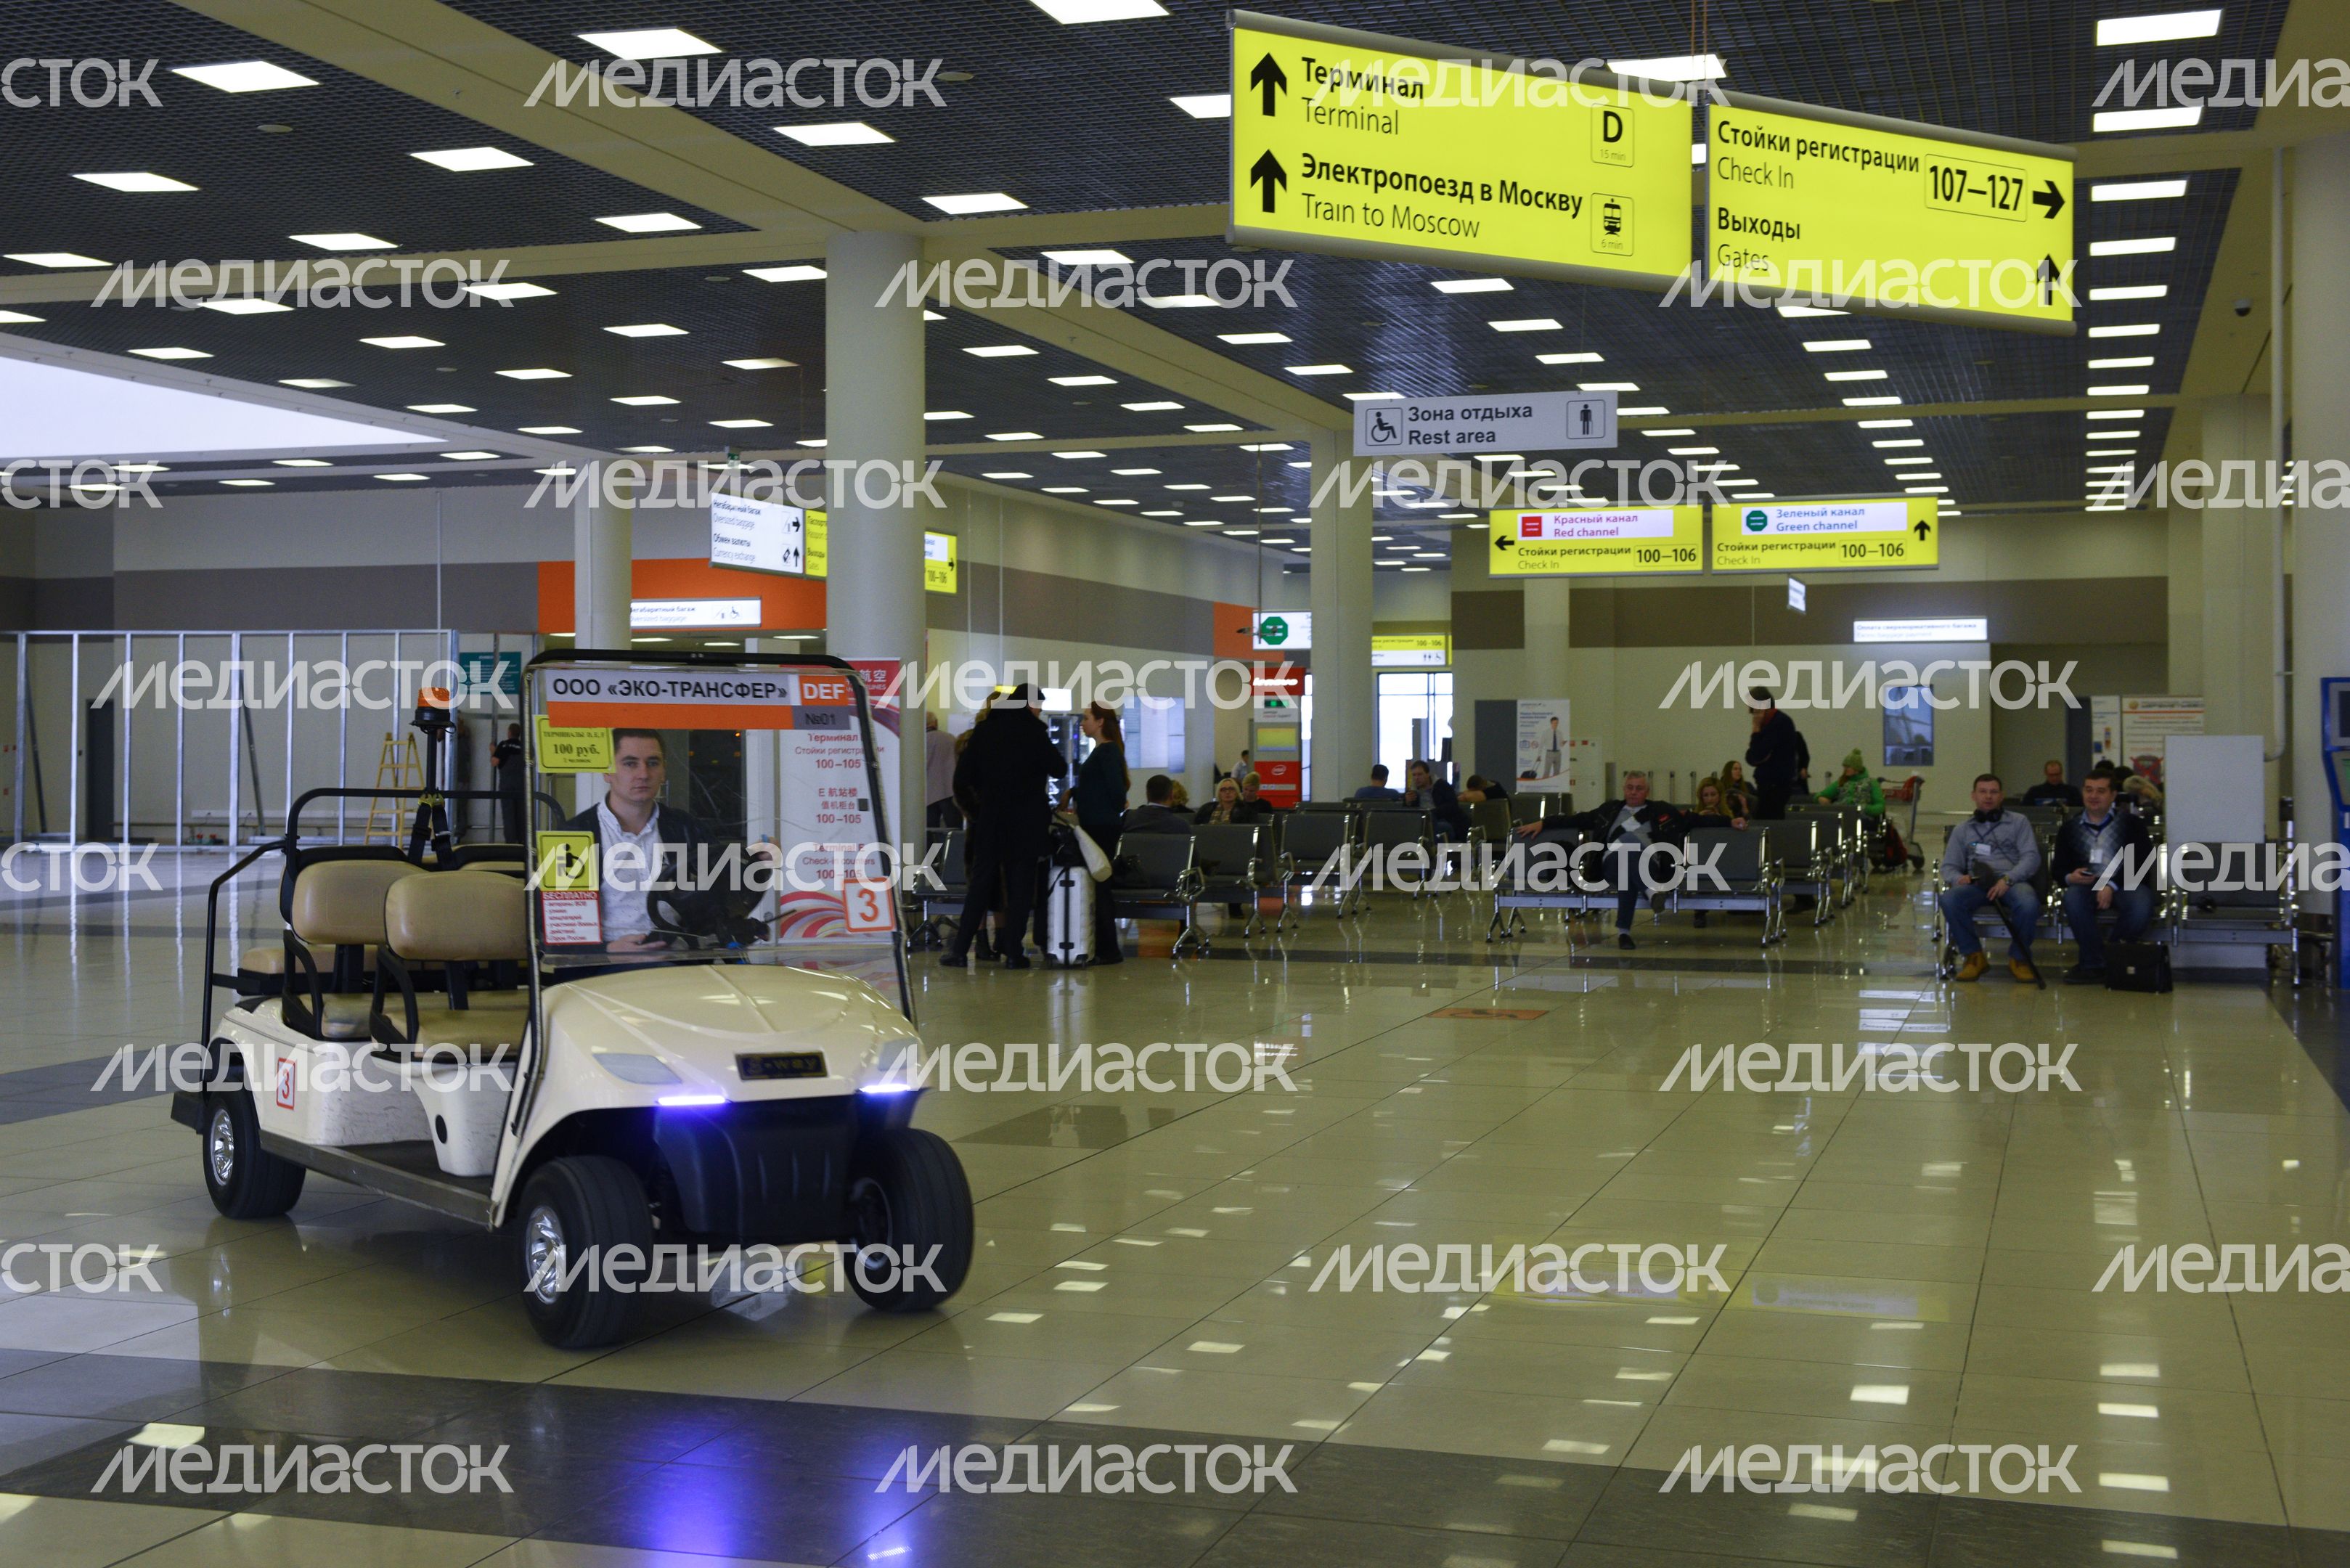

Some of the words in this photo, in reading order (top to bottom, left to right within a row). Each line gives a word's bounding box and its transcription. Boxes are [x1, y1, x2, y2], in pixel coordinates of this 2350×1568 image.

[1302, 57, 1424, 99] Терминал
[1302, 97, 1399, 135] Terminal
[1604, 110, 1623, 142] D
[1600, 150, 1609, 158] 15
[1611, 152, 1626, 160] min
[1718, 121, 1790, 153] Стойки
[1797, 137, 1919, 173] регистрации
[1718, 156, 1772, 187] Check
[1778, 165, 1794, 189] In
[1302, 152, 1473, 203] Электропоезд
[1480, 183, 1492, 200] в
[1499, 179, 1583, 219] Москву
[1302, 193, 1355, 222] Train
[1363, 203, 1384, 226] to
[1392, 205, 1480, 238] Moscow
[1718, 208, 1800, 242] Выходы
[1602, 239, 1607, 248] 6
[1608, 241, 1623, 250] min
[1718, 244, 1768, 271] Gates
[1408, 407, 1454, 422] Зона
[1461, 404, 1533, 422] отдыха
[1408, 430, 1450, 445] Rest
[1456, 429, 1496, 444] area
[1554, 515, 1602, 526] Красный
[1776, 508, 1828, 518] Зеленый
[1831, 507, 1865, 516] канал
[1554, 528, 1574, 537] Red
[1577, 527, 1619, 536] channel
[1776, 521, 1811, 531] Green
[1814, 520, 1858, 531] channel
[1518, 545, 1557, 556] Стойки
[1560, 547, 1631, 557] регистрации
[1717, 542, 1758, 552] Стойки
[1761, 542, 1836, 552] регистрации
[1518, 560, 1545, 569] Check
[1546, 560, 1559, 569] In
[1717, 555, 1748, 565] Check
[1751, 555, 1761, 565] In
[553, 678, 600, 695] ООО
[608, 680, 787, 698] «ЭКО-ТРАНСФЕР»
[802, 683, 845, 700] DEF
[804, 713, 836, 725] №01
[808, 733, 858, 742] Терминал
[554, 744, 573, 754] 100
[576, 744, 600, 757] руб.
[858, 889, 878, 922] 3
[282, 1069, 290, 1099] 3
